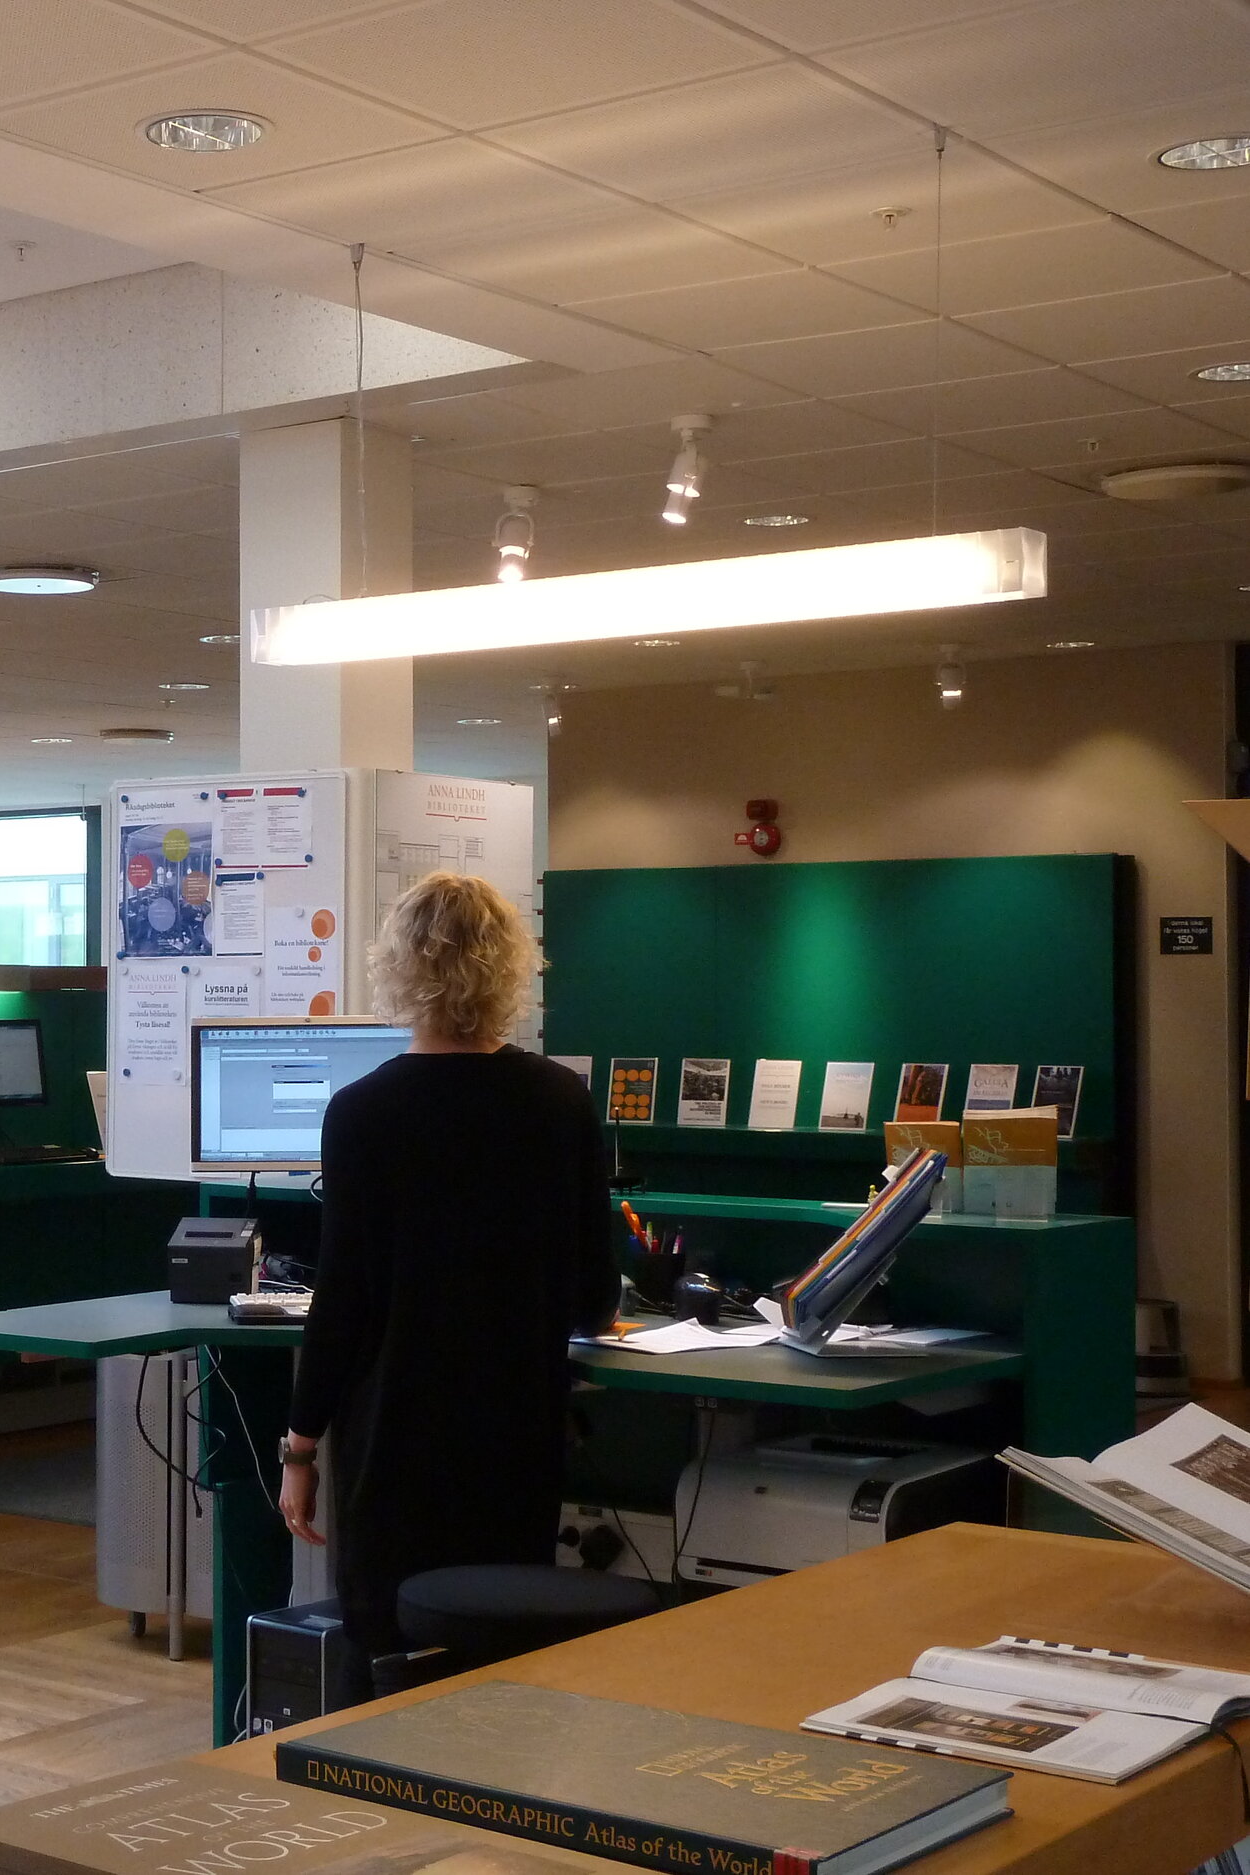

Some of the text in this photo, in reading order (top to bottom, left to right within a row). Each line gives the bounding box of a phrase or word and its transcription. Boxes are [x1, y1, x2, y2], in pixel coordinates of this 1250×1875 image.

[429, 784, 485, 801] ANNA LINDH
[427, 801, 486, 814] BIBLIOTEKET
[1177, 935, 1194, 944] 150
[129, 974, 177, 982] ANNA LINDH
[205, 983, 248, 994] Lyssna på
[694, 1750, 809, 1789] Atlas
[773, 1759, 912, 1802] World
[30, 1777, 179, 1819] THE TIMES
[751, 1780, 779, 1795] of
[107, 1792, 290, 1852] ATLAS
[323, 1763, 772, 1875] NATIONAL GEOGRAPHIC Atlas of the World
[156, 1811, 387, 1875] WORLD
